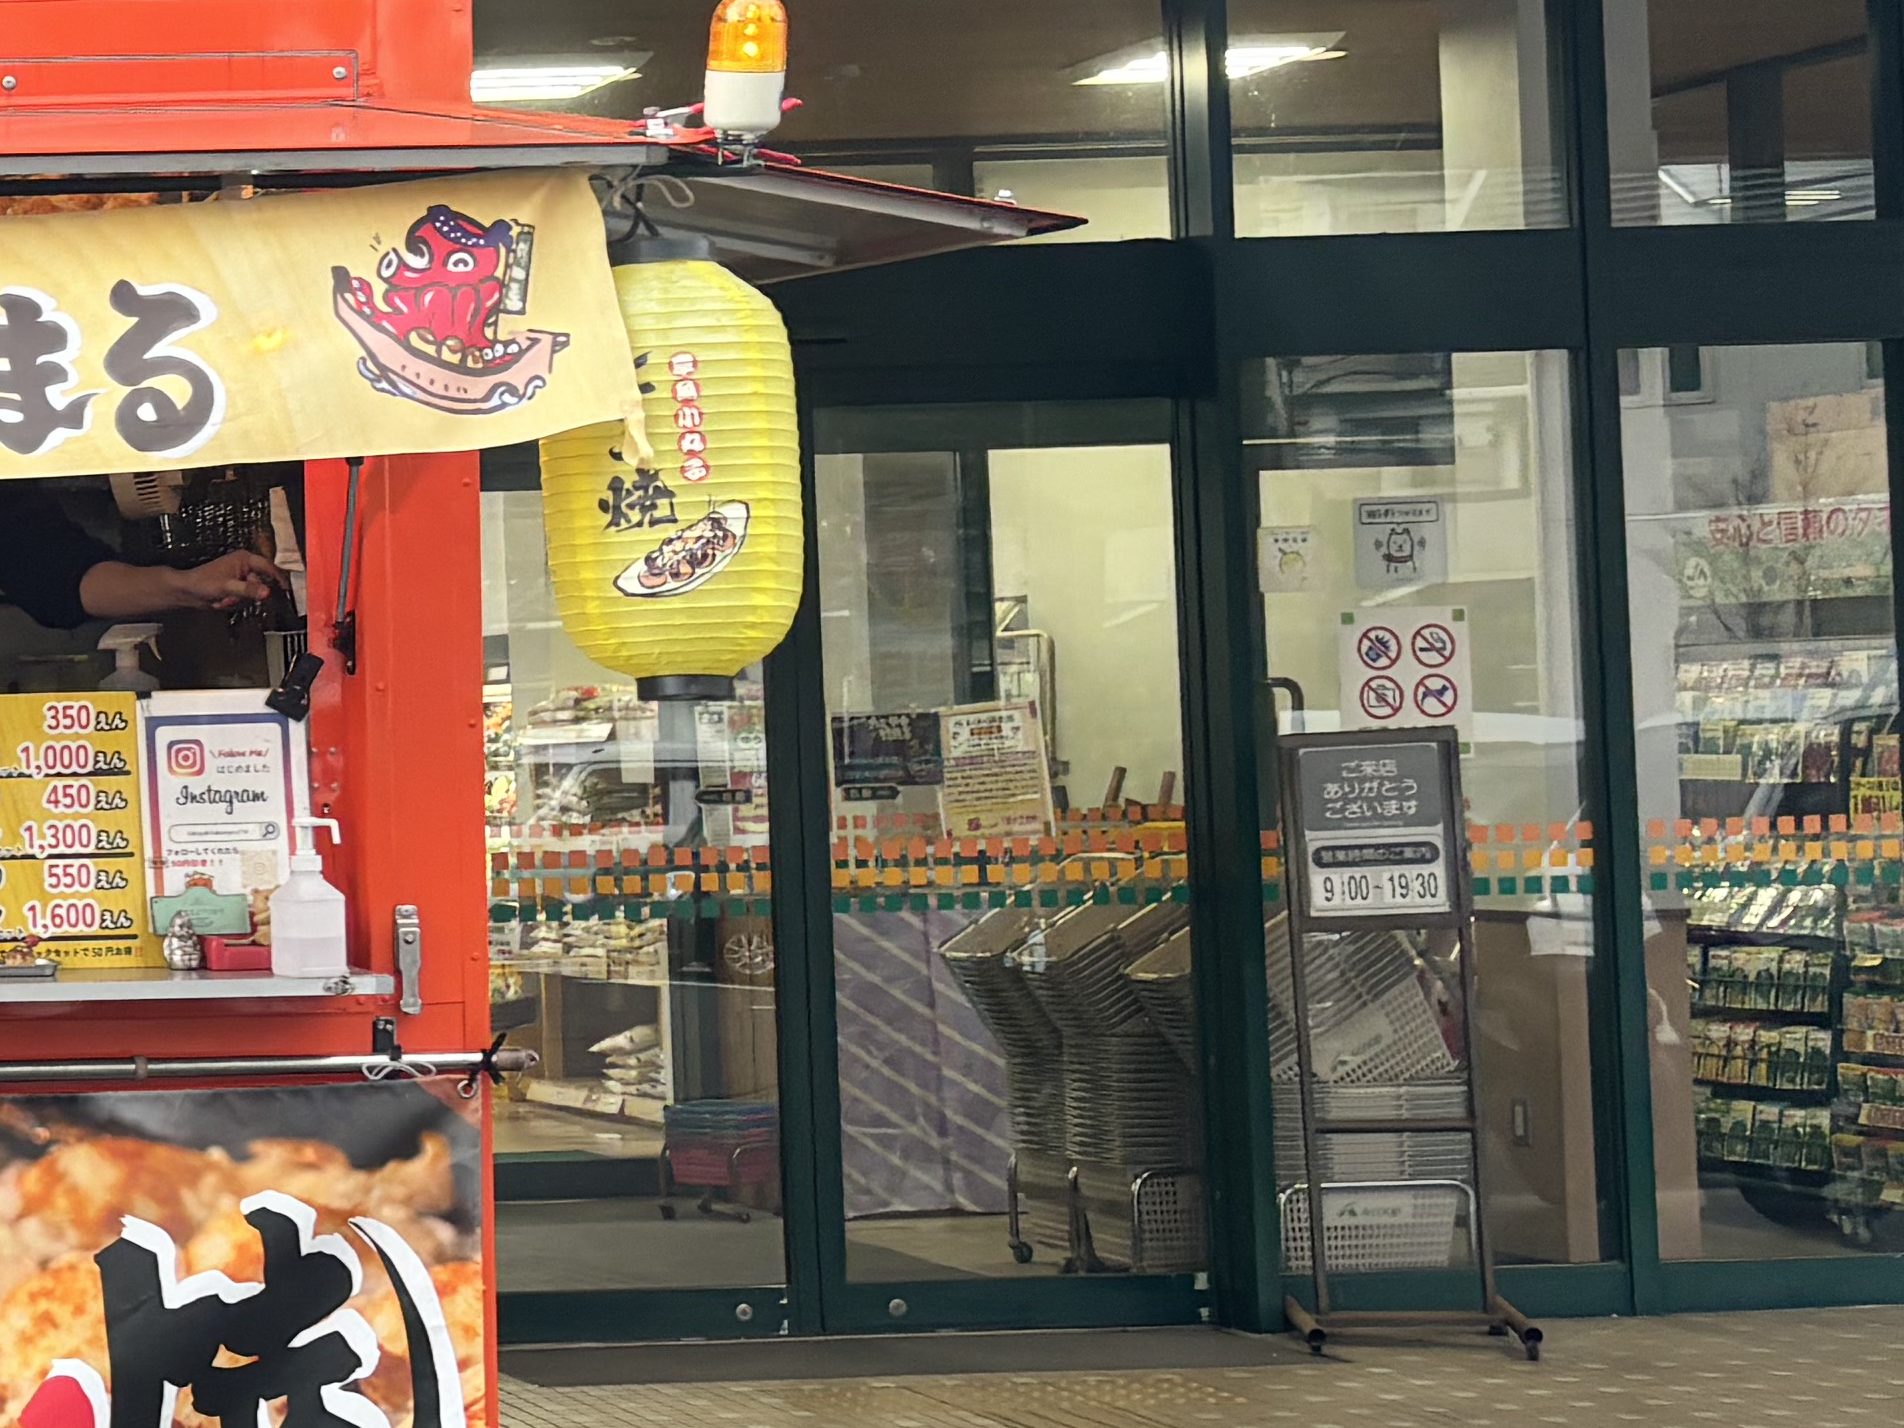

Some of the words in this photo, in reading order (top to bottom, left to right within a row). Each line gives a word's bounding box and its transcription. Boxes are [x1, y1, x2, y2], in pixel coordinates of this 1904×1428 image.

[1341, 759, 1398, 778] ご来店
[1323, 779, 1418, 799] ありがとう
[176, 785, 268, 815] Instagram
[1324, 799, 1419, 819] ございます
